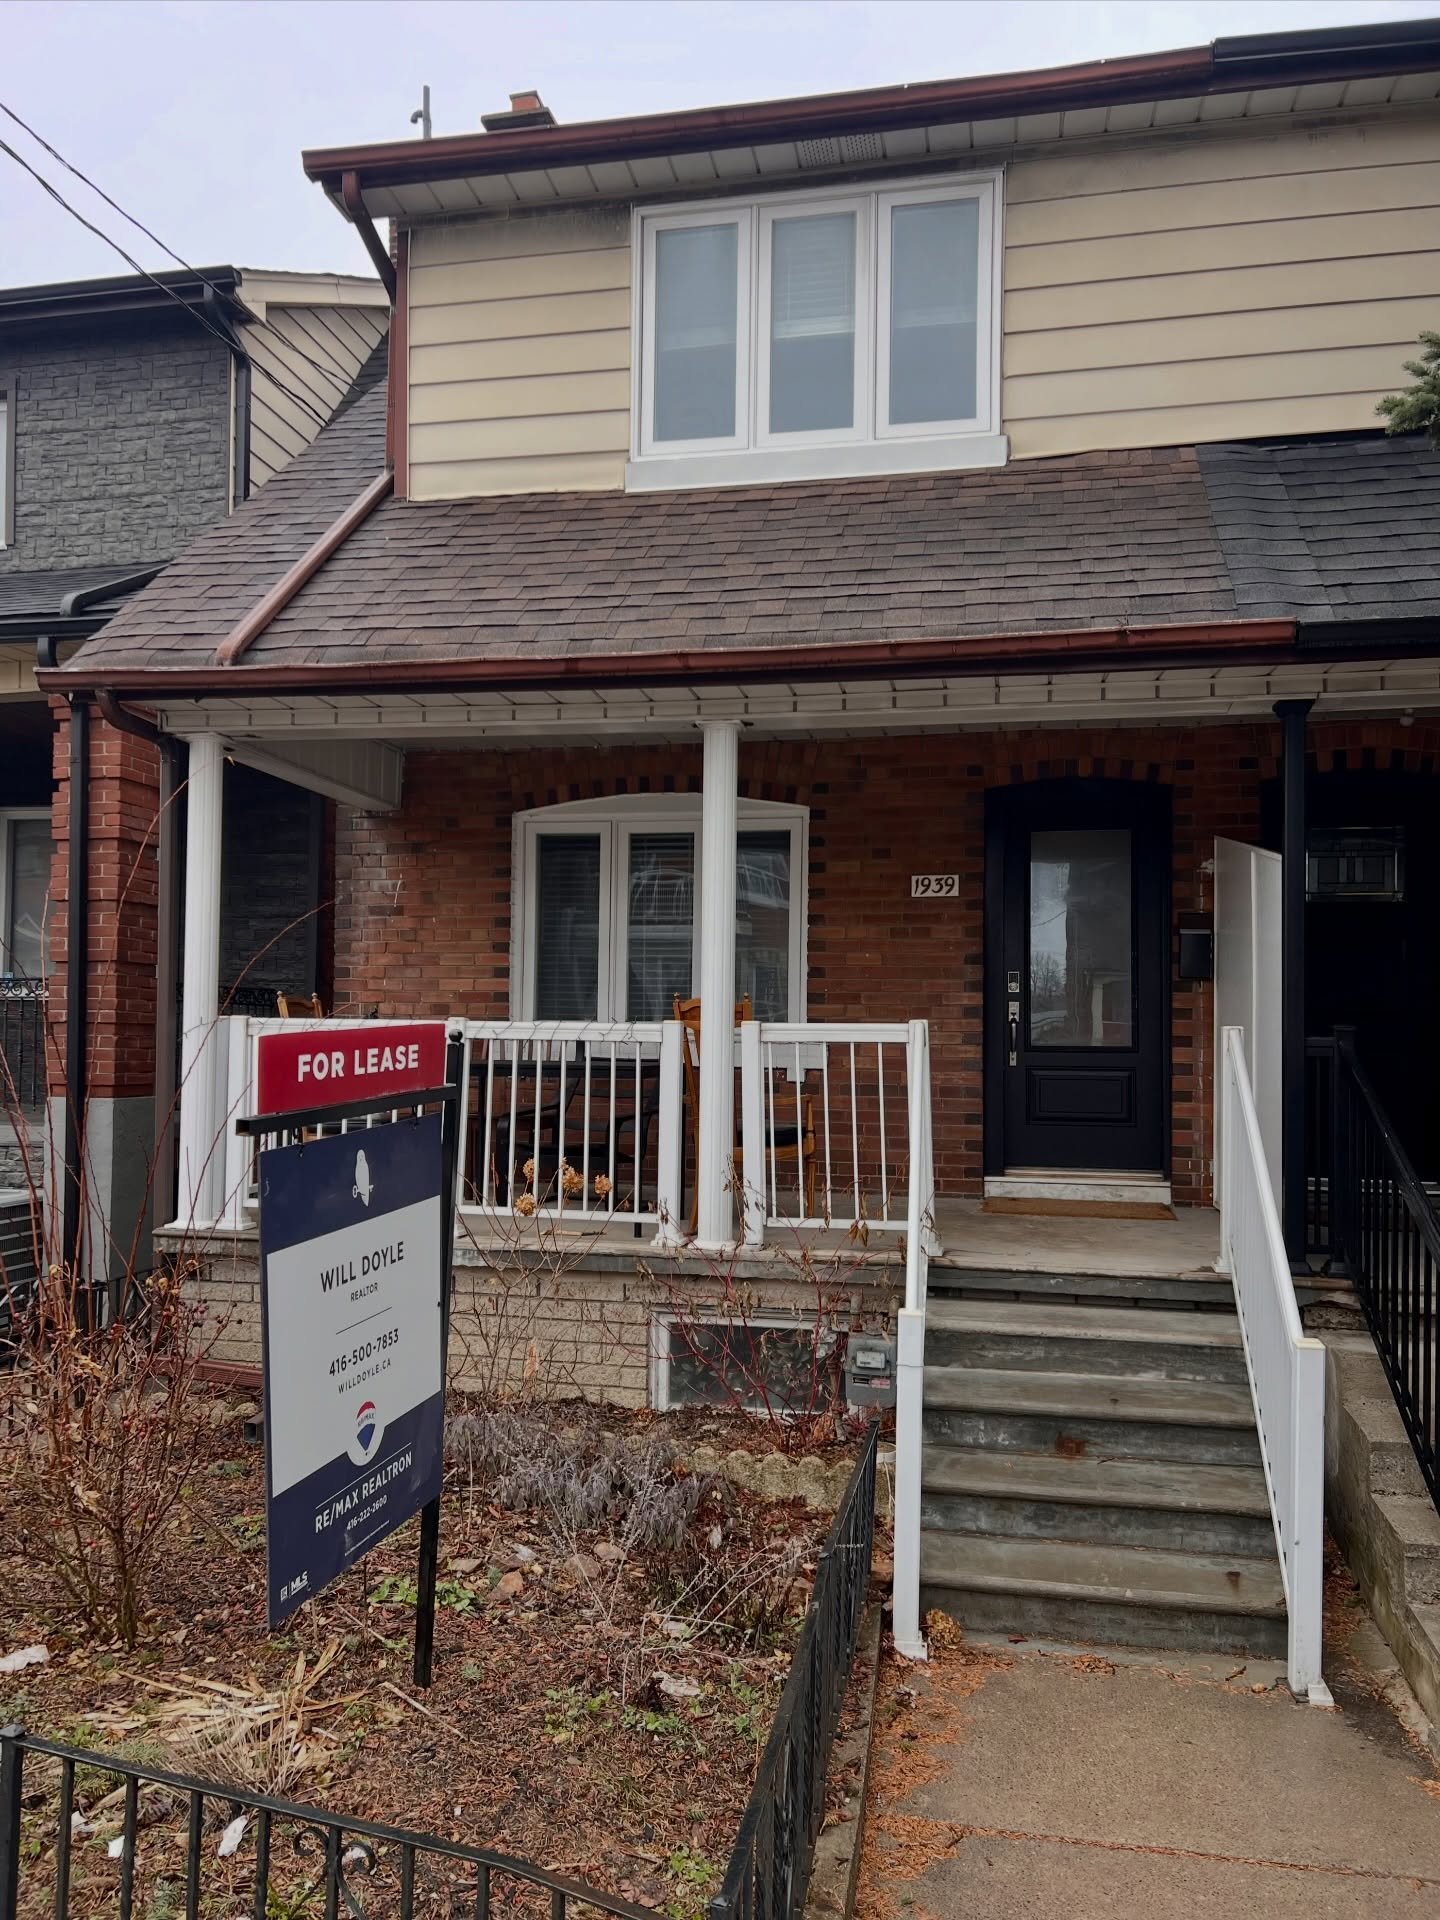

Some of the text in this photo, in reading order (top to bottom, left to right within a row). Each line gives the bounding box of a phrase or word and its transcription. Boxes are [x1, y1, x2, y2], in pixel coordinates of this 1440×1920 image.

[914, 876, 955, 896] 1939
[297, 1044, 419, 1083] FOR LEASE
[320, 1241, 404, 1293] WILL DOYLE
[350, 1282, 378, 1302] REALTOR
[329, 1328, 399, 1376] 416-500-7853
[338, 1358, 391, 1394] WILLDOYLE.CA
[315, 1451, 412, 1534] RE/MAX REALTRON
